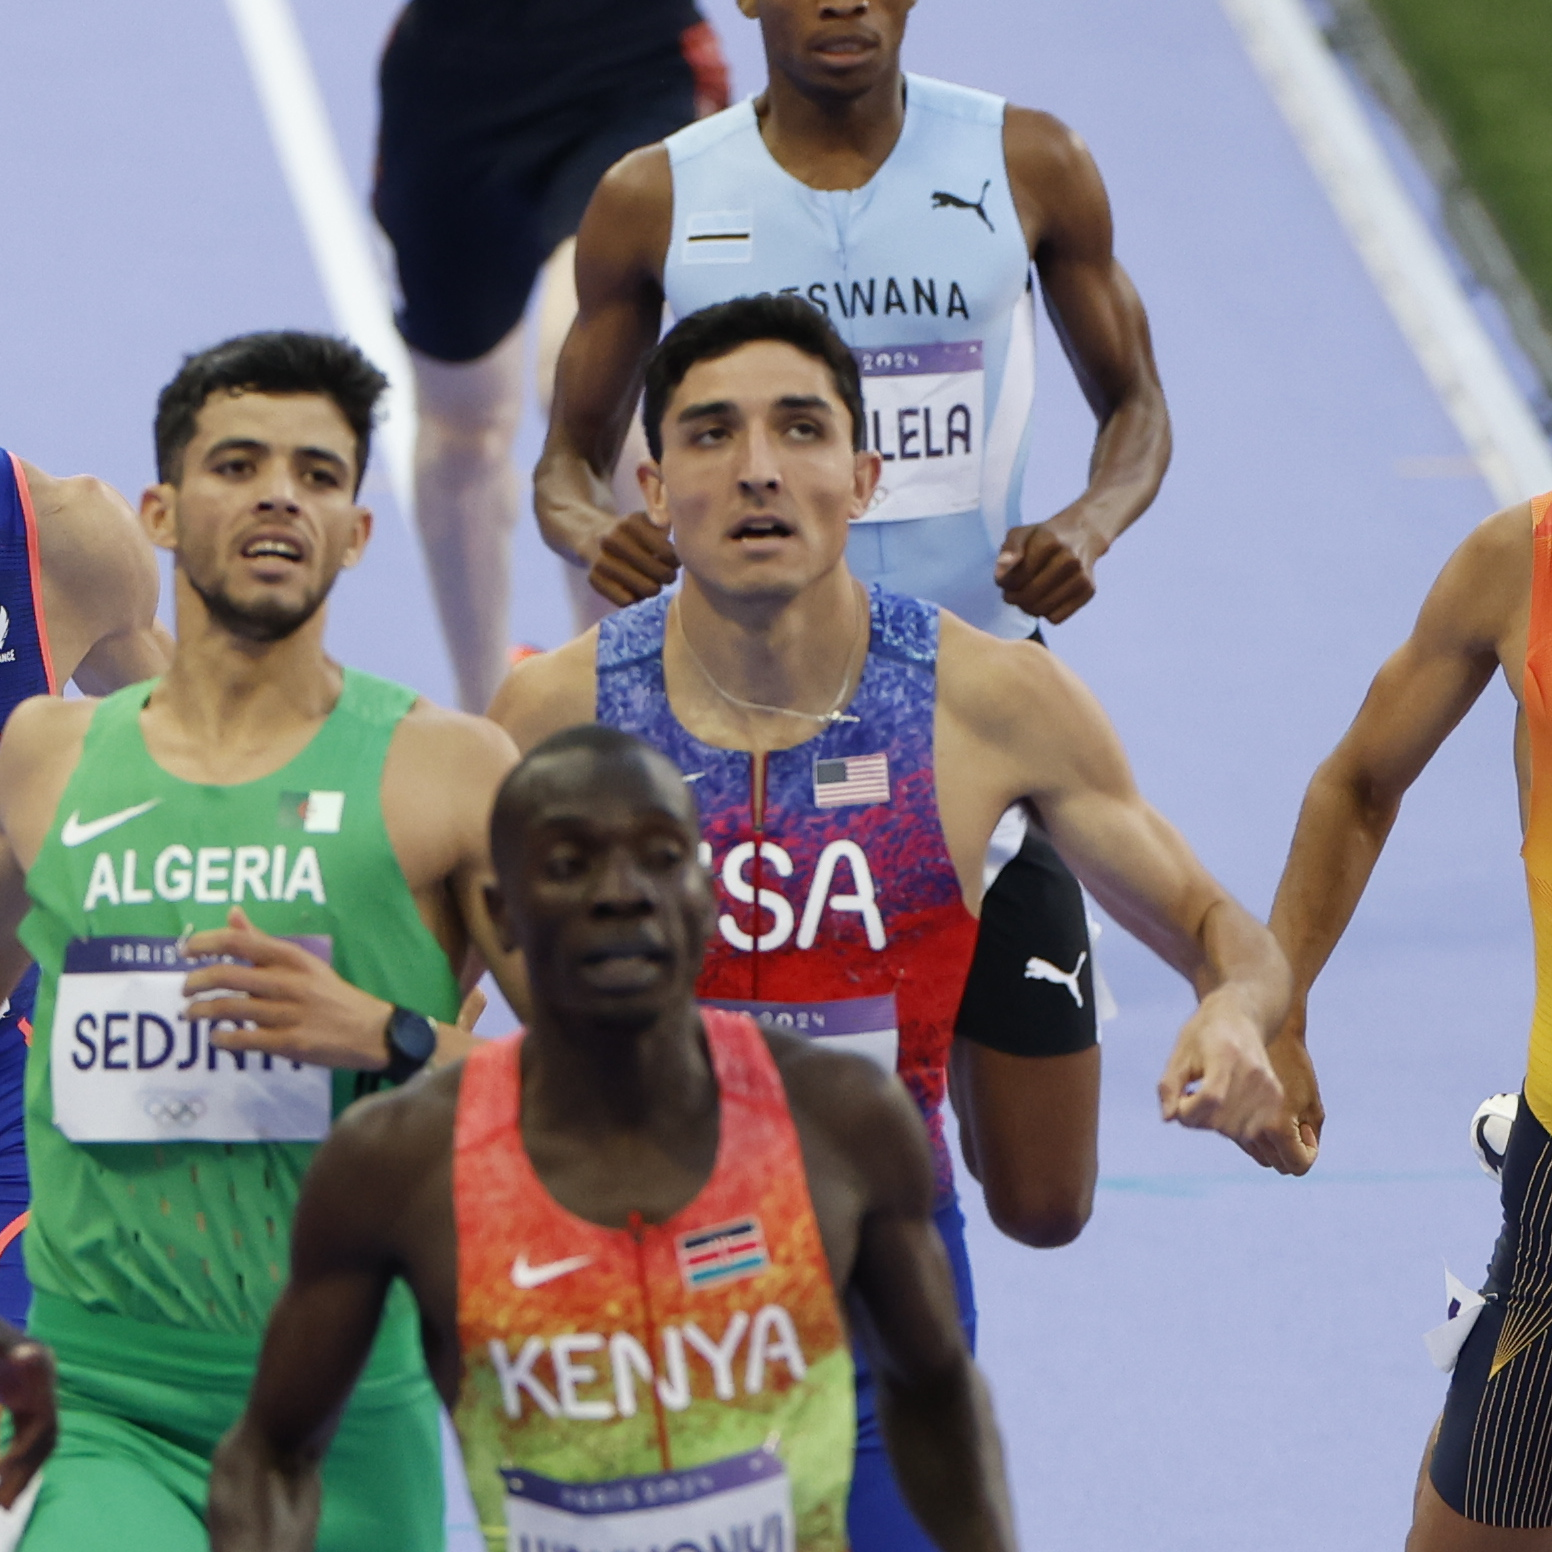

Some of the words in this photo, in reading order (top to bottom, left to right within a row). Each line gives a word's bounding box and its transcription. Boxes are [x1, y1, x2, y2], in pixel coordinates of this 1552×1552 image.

[863, 403, 973, 461] LELA
[84, 844, 326, 911] ALGERIA
[697, 840, 887, 952] SA
[489, 1305, 807, 1420] KENYA
